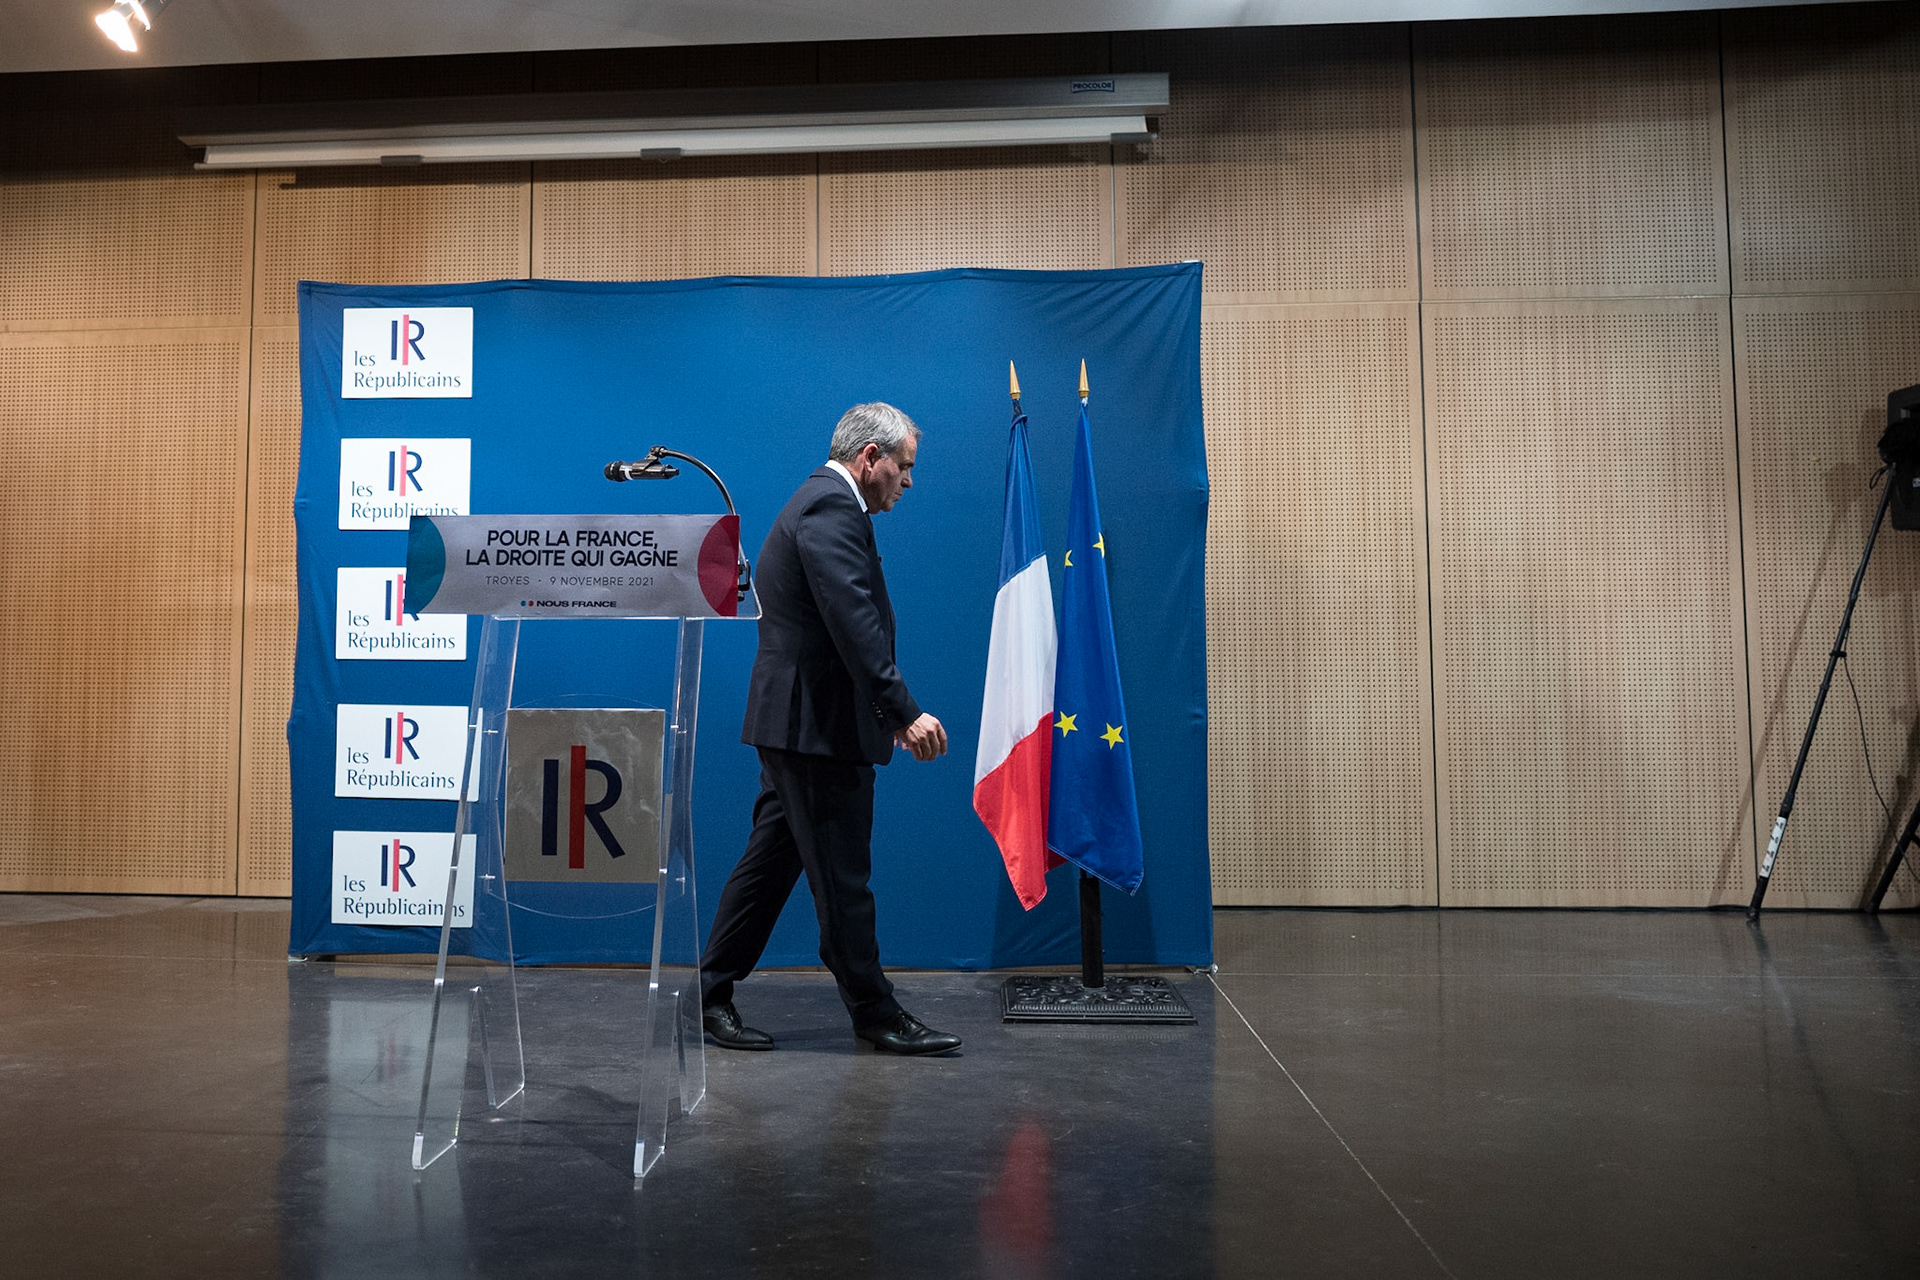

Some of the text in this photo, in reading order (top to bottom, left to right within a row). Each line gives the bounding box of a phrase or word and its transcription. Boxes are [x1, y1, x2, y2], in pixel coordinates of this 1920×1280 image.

[354, 350, 376, 367] les
[354, 371, 461, 391] Républicains
[351, 481, 373, 497] les
[351, 502, 458, 522] Républicains
[487, 529, 658, 550] POUR LA FRANCE,
[466, 549, 678, 567] LA DROITE QUI GAGNE
[485, 576, 654, 586] TROYES 9 NOVEMBRE 2021
[348, 610, 370, 627] les
[348, 632, 455, 652] Républicains
[347, 747, 369, 764] les
[347, 769, 455, 790] Républicains
[343, 875, 366, 892] les
